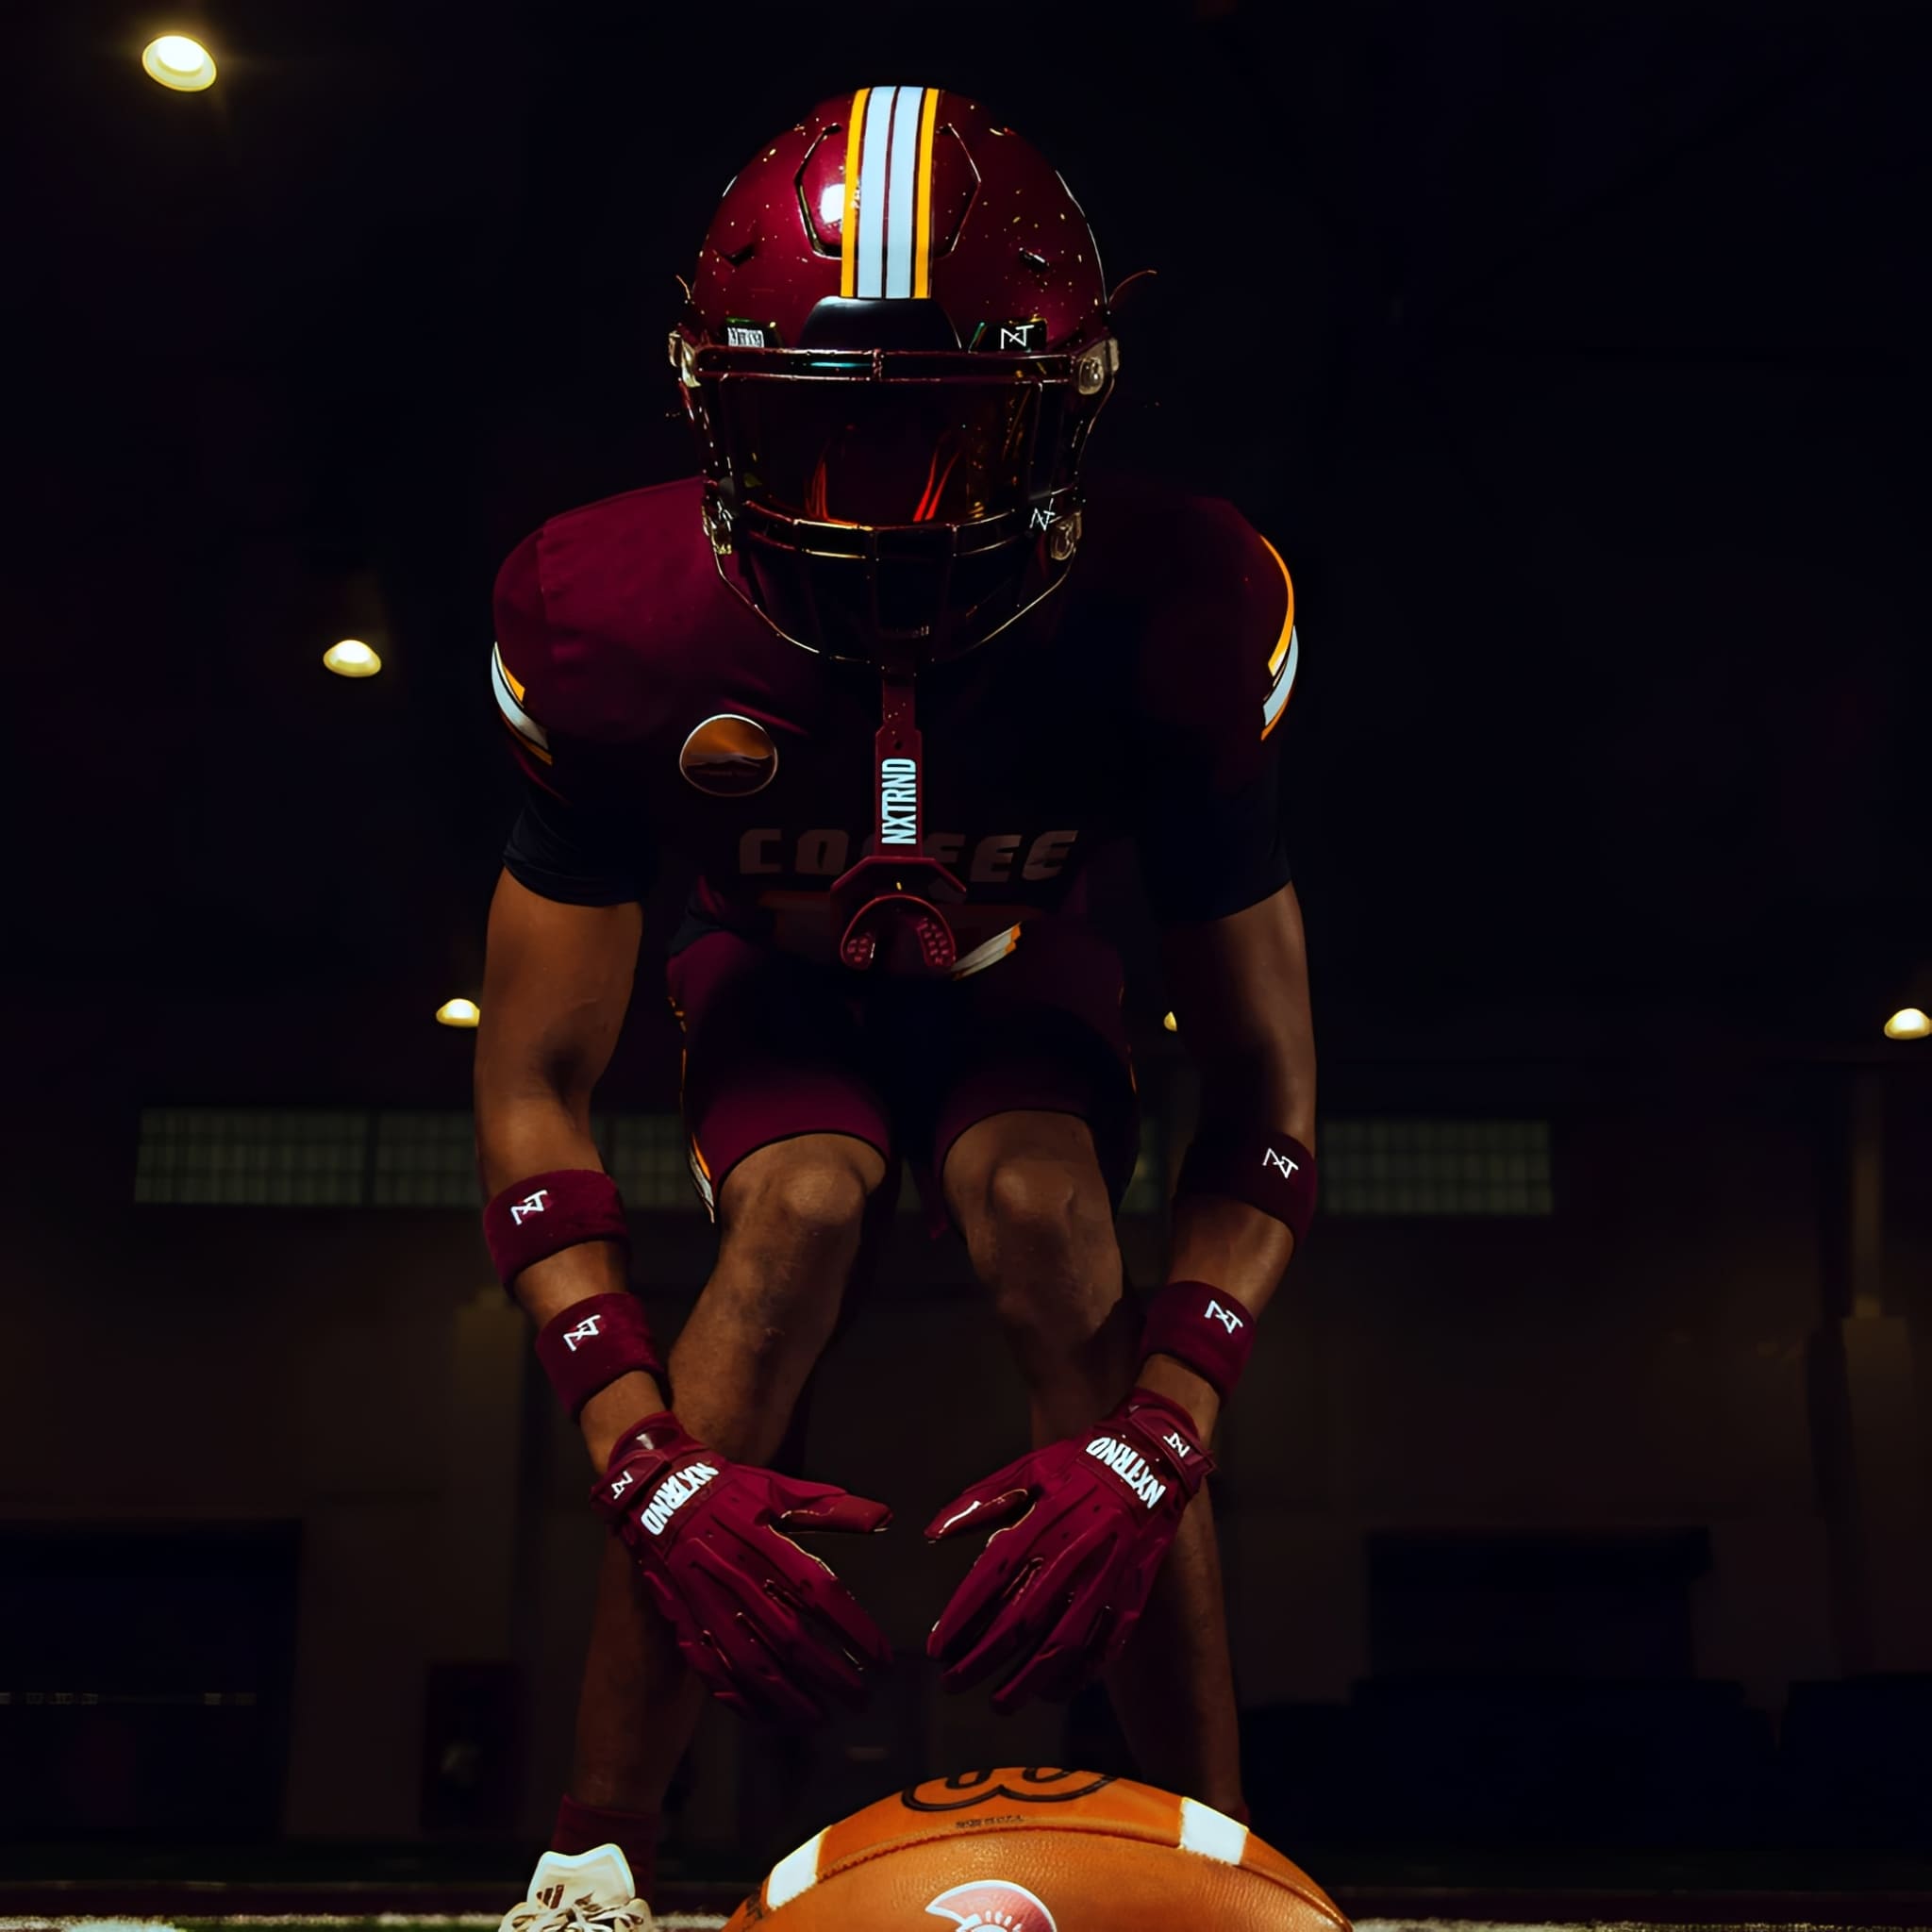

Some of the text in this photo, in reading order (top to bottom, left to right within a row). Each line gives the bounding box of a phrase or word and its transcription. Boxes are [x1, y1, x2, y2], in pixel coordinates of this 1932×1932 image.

[881, 758, 917, 844] NXTRND
[739, 827, 1079, 883] COFEE
[641, 1462, 720, 1536] NXTRND
[1086, 1436, 1166, 1508] NXTRND
